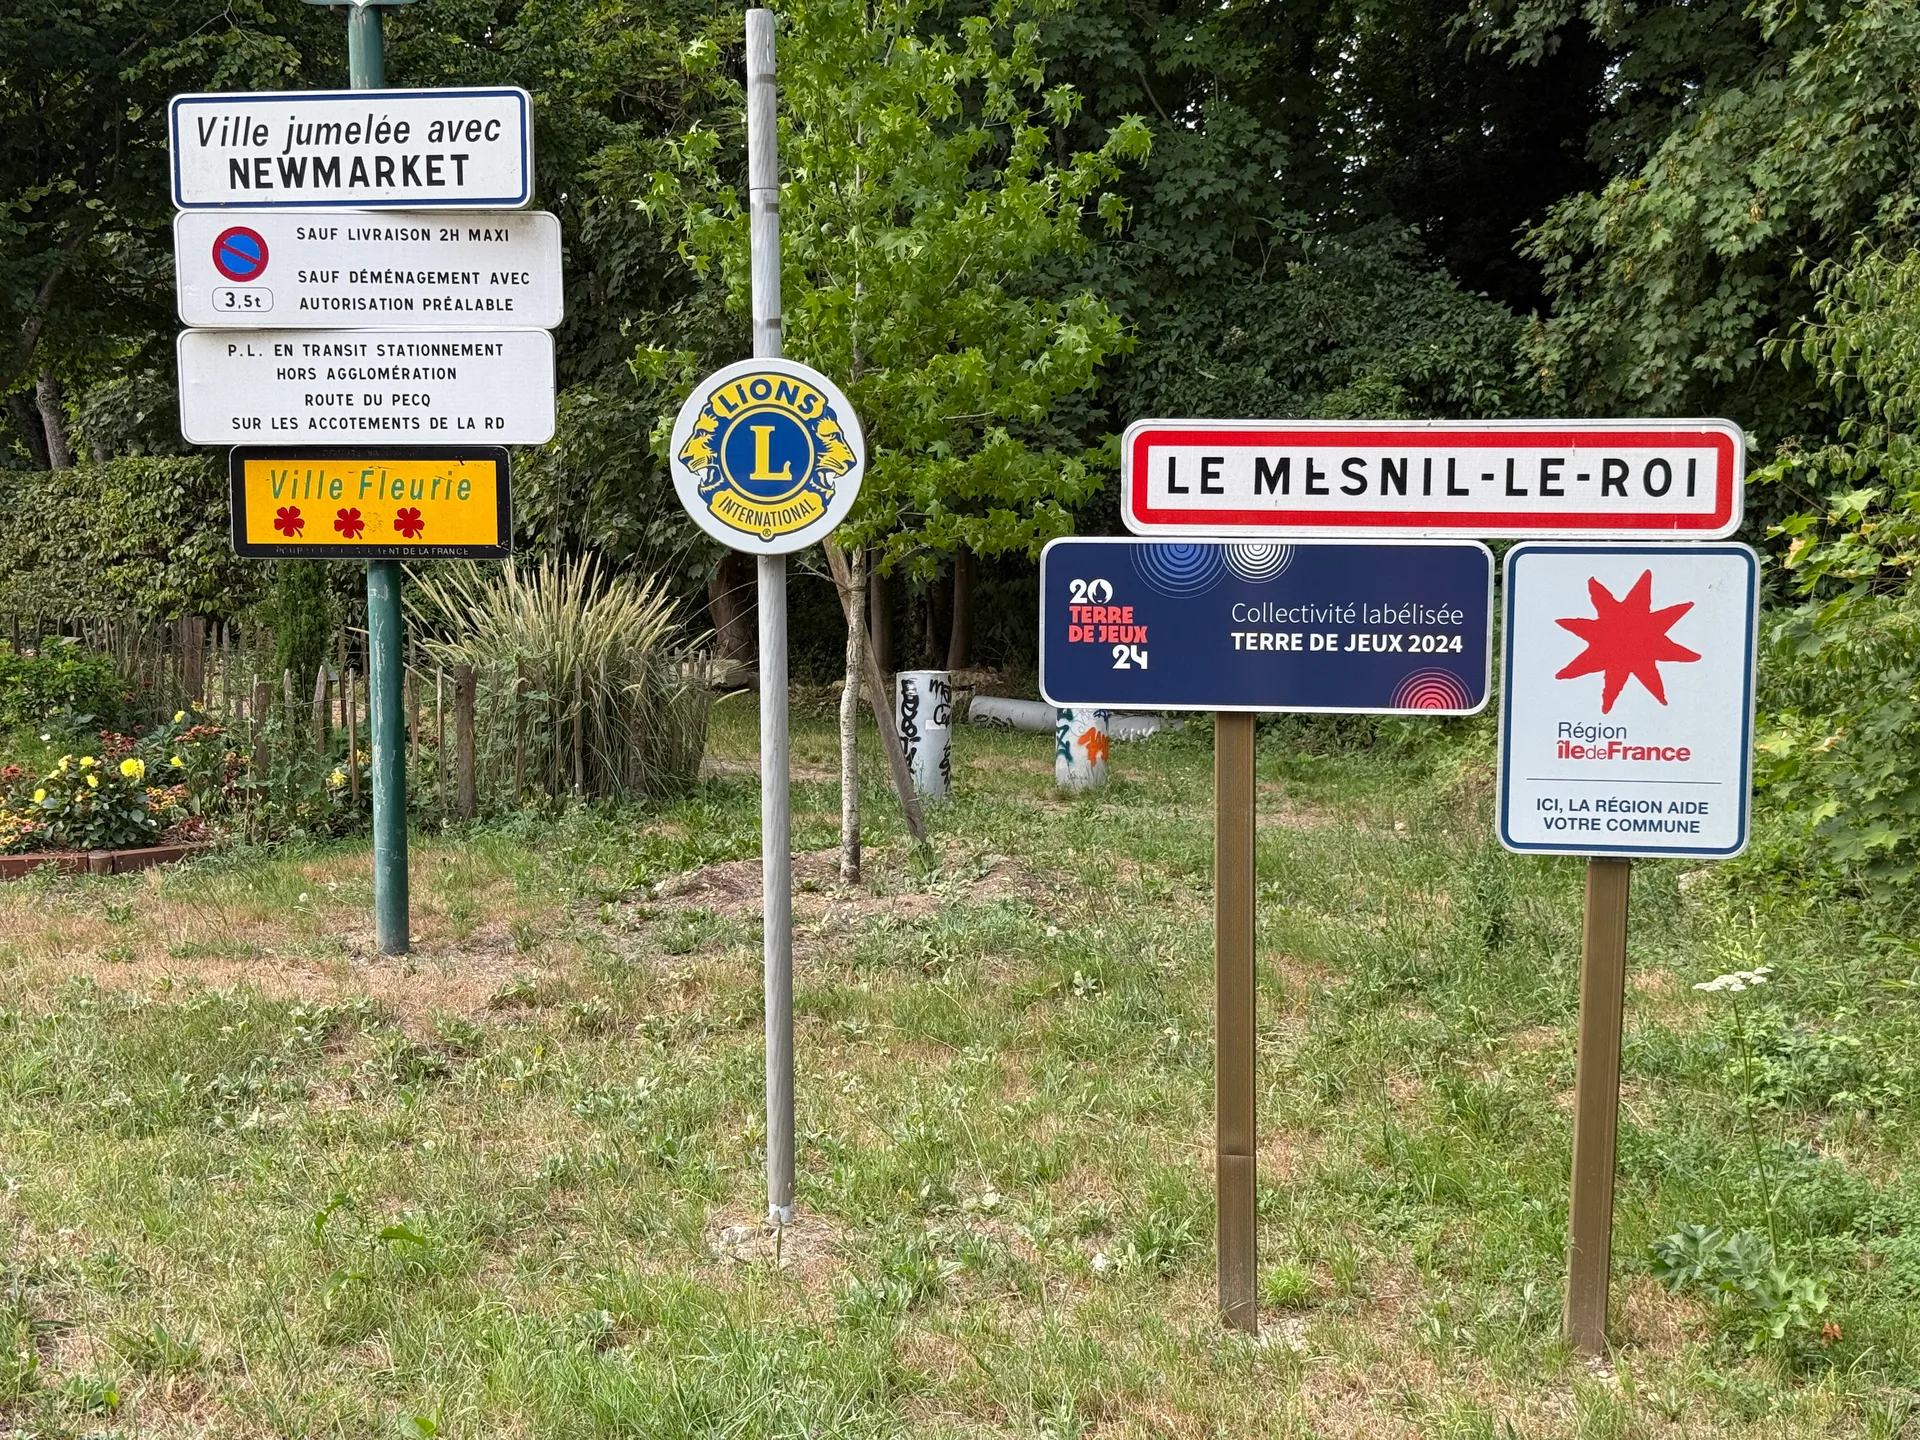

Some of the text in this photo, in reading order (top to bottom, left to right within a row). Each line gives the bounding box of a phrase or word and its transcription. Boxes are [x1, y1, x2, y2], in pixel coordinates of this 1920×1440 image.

[197, 113, 502, 156] Ville jumelée avec
[229, 153, 470, 190] NEWMARKET
[296, 227, 510, 242] SAUF LIVRAISON 2H MAXI
[297, 268, 531, 285] SAUF DÉMÉNAGEMENT AVEC
[224, 291, 262, 311] 3,5t
[299, 294, 514, 311] AUTORISATION PRÉALABLE
[227, 343, 504, 357] P.L. EN TRANSIT STATIONNEMENT
[276, 365, 457, 380] HORS AGGLOMÉRATION
[304, 393, 431, 408] ROUTE DU PECQ
[718, 378, 819, 415] LIONS
[231, 417, 505, 430] SUR LES ACCOTEMENTS DE LA RD
[750, 425, 792, 481] L
[270, 469, 473, 501] Ville Fleurie
[1167, 456, 1225, 495] LE
[718, 496, 817, 527] INTERNATIONAL
[403, 547, 416, 555] DE
[418, 547, 430, 555] LA
[431, 547, 469, 556] FRANCE
[1069, 606, 1133, 624] TERRE
[1230, 602, 1464, 626] Collectivité labélisée
[1068, 625, 1148, 643] DE JEUX
[1230, 632, 1463, 654] TERRE DE JEUX 2024
[1112, 644, 1148, 669] 24
[1557, 721, 1628, 743] Région
[1536, 796, 1709, 815] ICI, LA RÉGION AIDE
[1543, 817, 1701, 834] VOTRE COMMUNE
